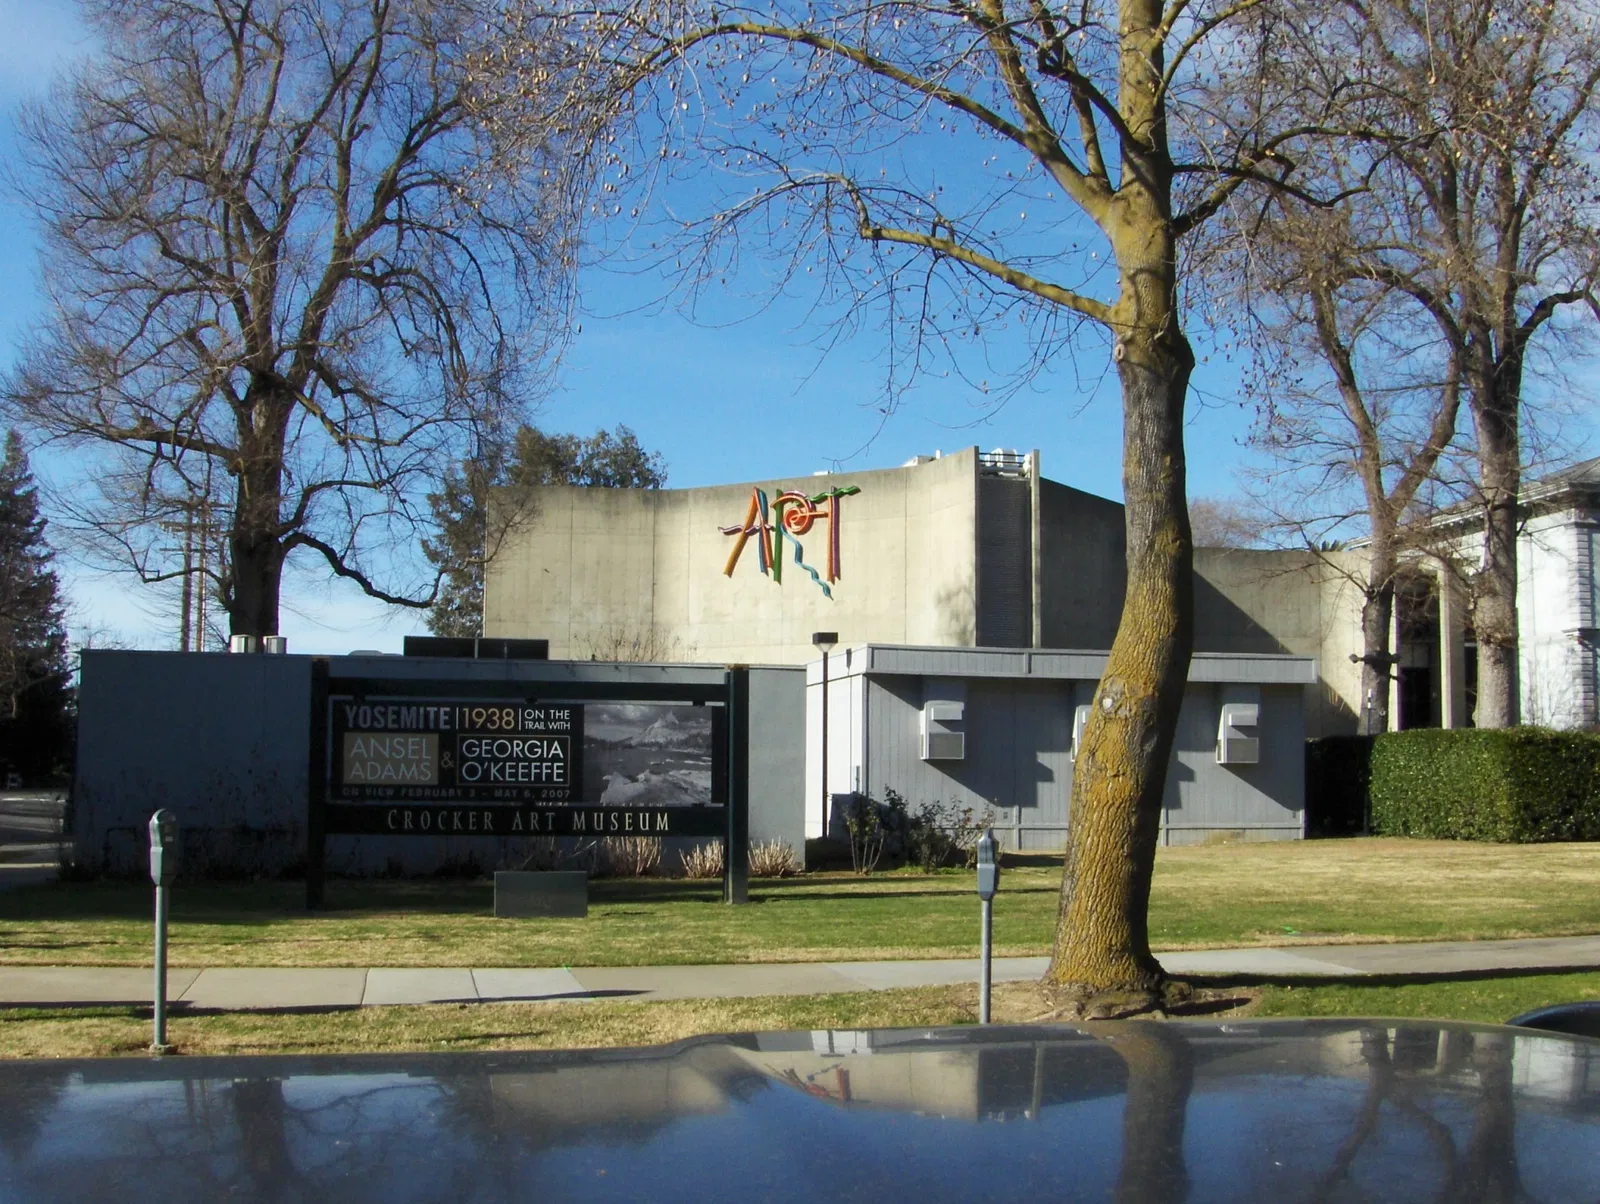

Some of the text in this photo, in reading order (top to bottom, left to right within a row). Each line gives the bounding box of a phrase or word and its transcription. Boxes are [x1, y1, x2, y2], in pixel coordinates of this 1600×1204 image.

[346, 706, 515, 730] YOSEMITE 1938
[524, 709, 570, 720] ON THE
[524, 721, 571, 731] TRAIL WITH
[351, 738, 431, 759] ANSEL
[462, 739, 564, 758] GEORGIA
[441, 751, 454, 769] &
[351, 761, 431, 781] ADAMS
[462, 761, 564, 782] O'KEEFFE
[342, 788, 359, 797] ON
[366, 788, 394, 797] VIEW
[401, 788, 463, 797] FEBRUARY
[468, 788, 476, 798] 3
[494, 788, 517, 798] MAY
[541, 789, 571, 798] 2007
[387, 809, 669, 831] CROCKER ART MUSEUM
